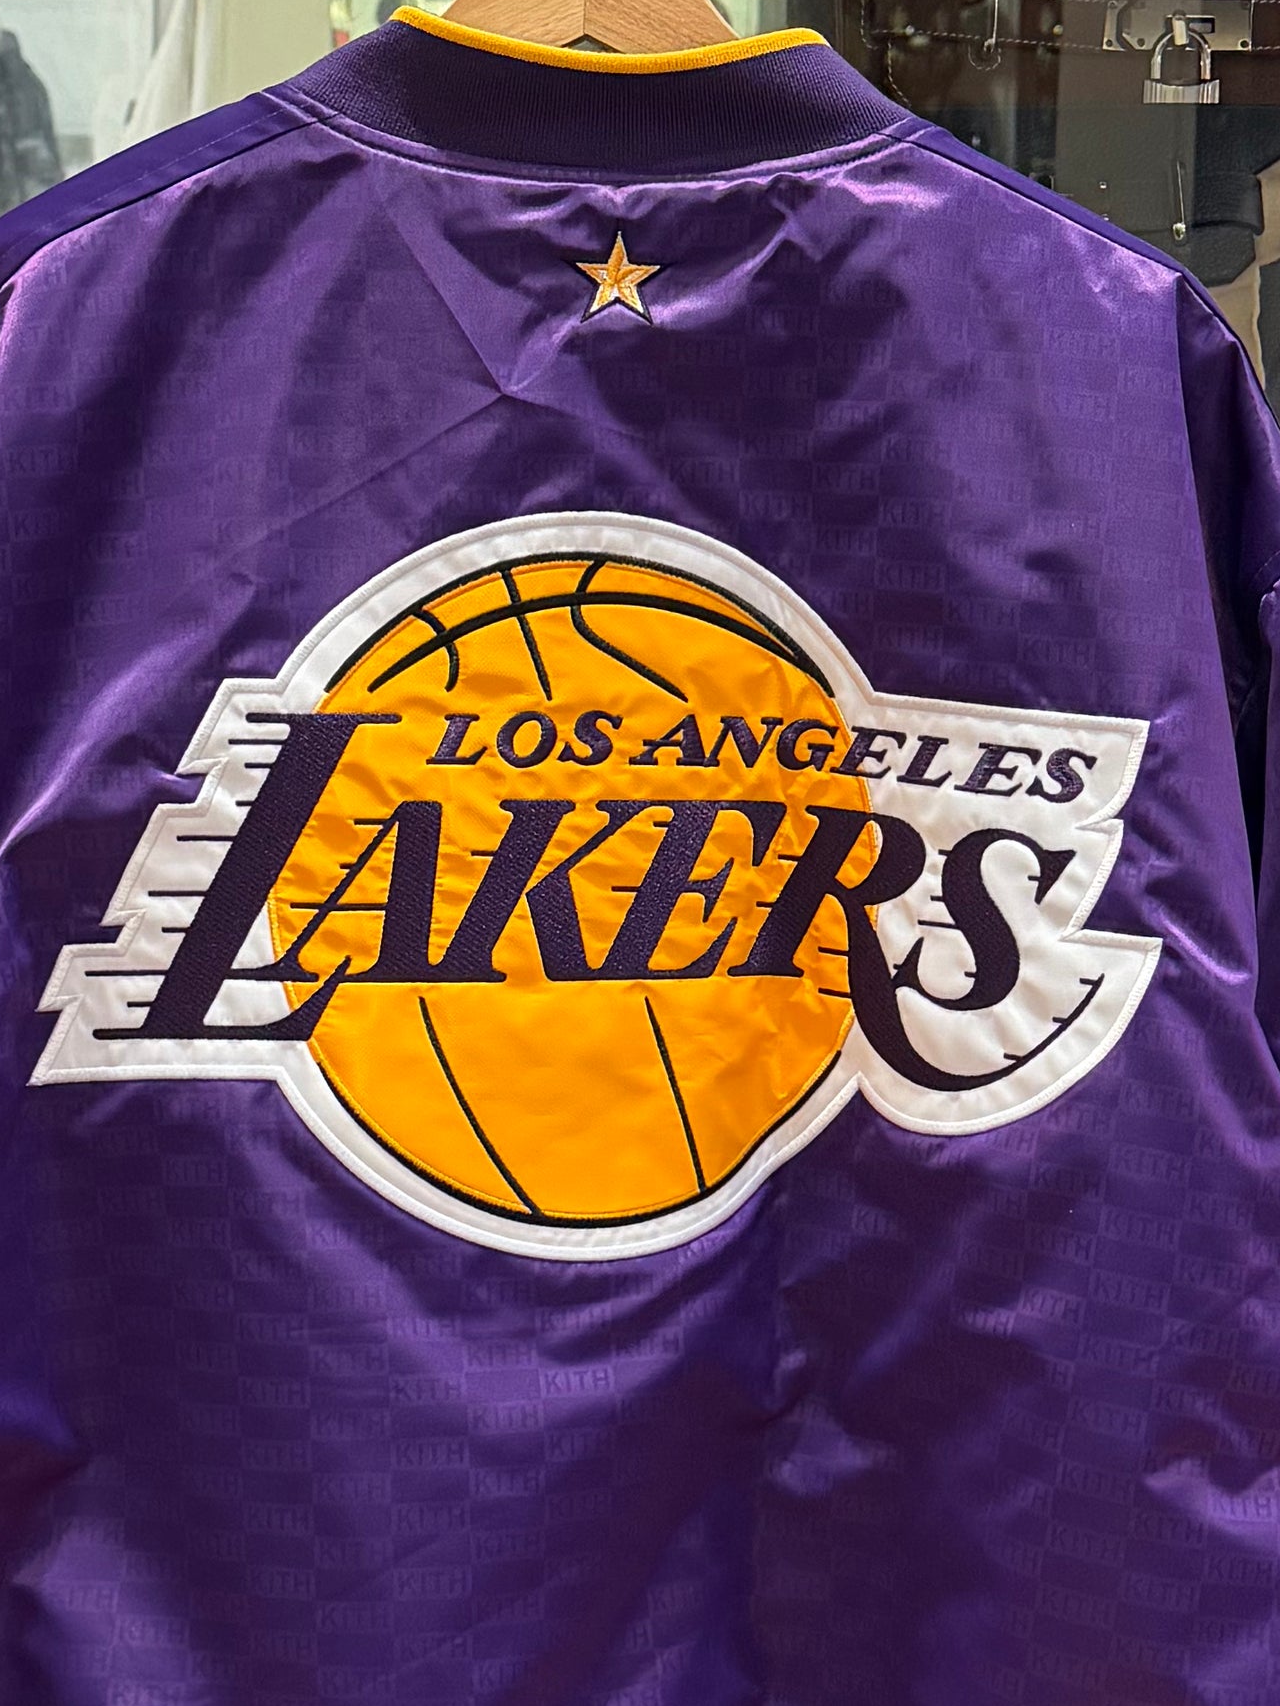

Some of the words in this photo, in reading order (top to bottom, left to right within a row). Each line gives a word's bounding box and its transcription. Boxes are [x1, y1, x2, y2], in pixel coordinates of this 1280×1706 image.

[425, 710, 623, 769] LOS
[629, 713, 1098, 804] ANGELES
[92, 711, 1104, 1092] LAKERS
